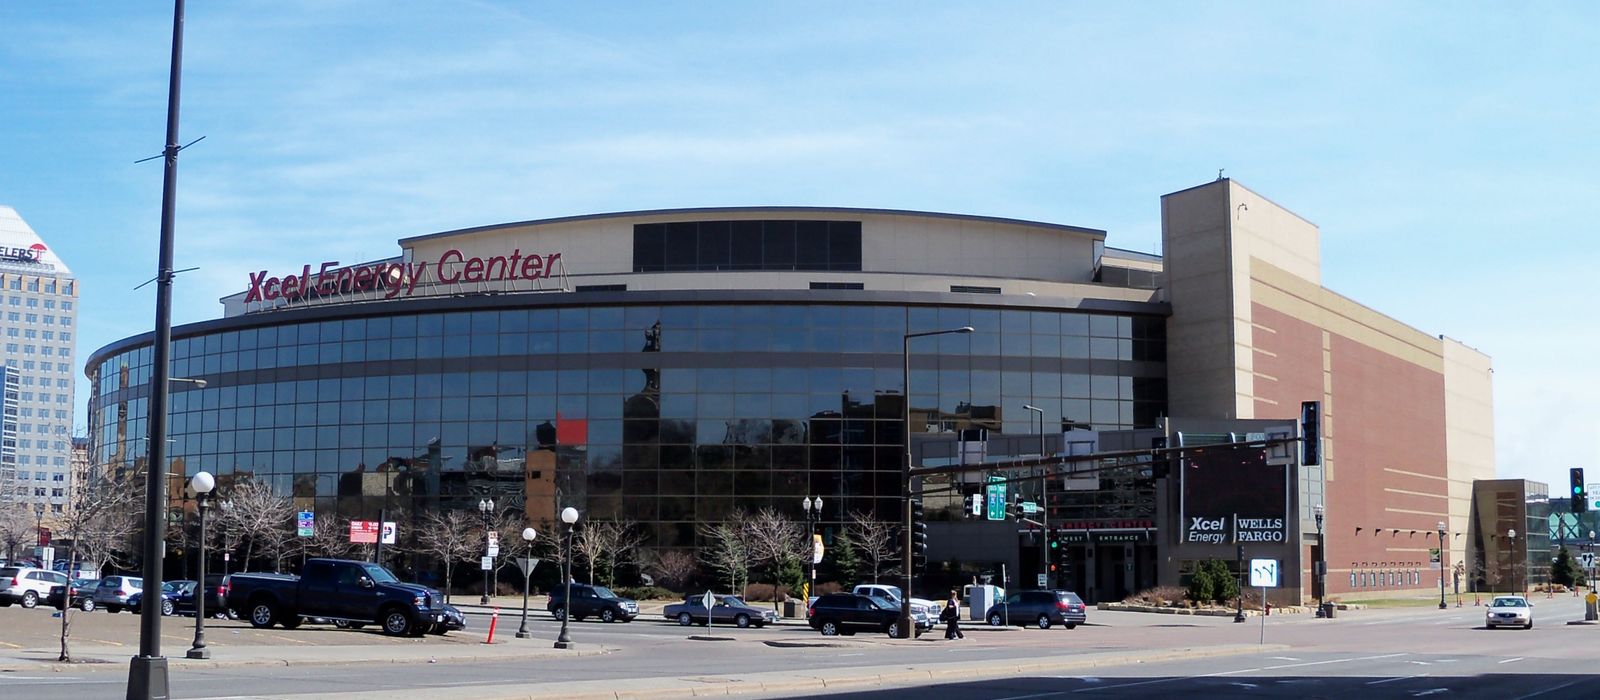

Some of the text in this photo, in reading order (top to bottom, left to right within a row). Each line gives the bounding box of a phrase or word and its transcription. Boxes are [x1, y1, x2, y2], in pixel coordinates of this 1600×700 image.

[244, 249, 562, 304] Xcel Energy Center
[1189, 517, 1225, 530] Xcel
[1238, 518, 1283, 529] WELLS
[1188, 531, 1226, 544] Energy
[1238, 531, 1283, 542] FARGO
